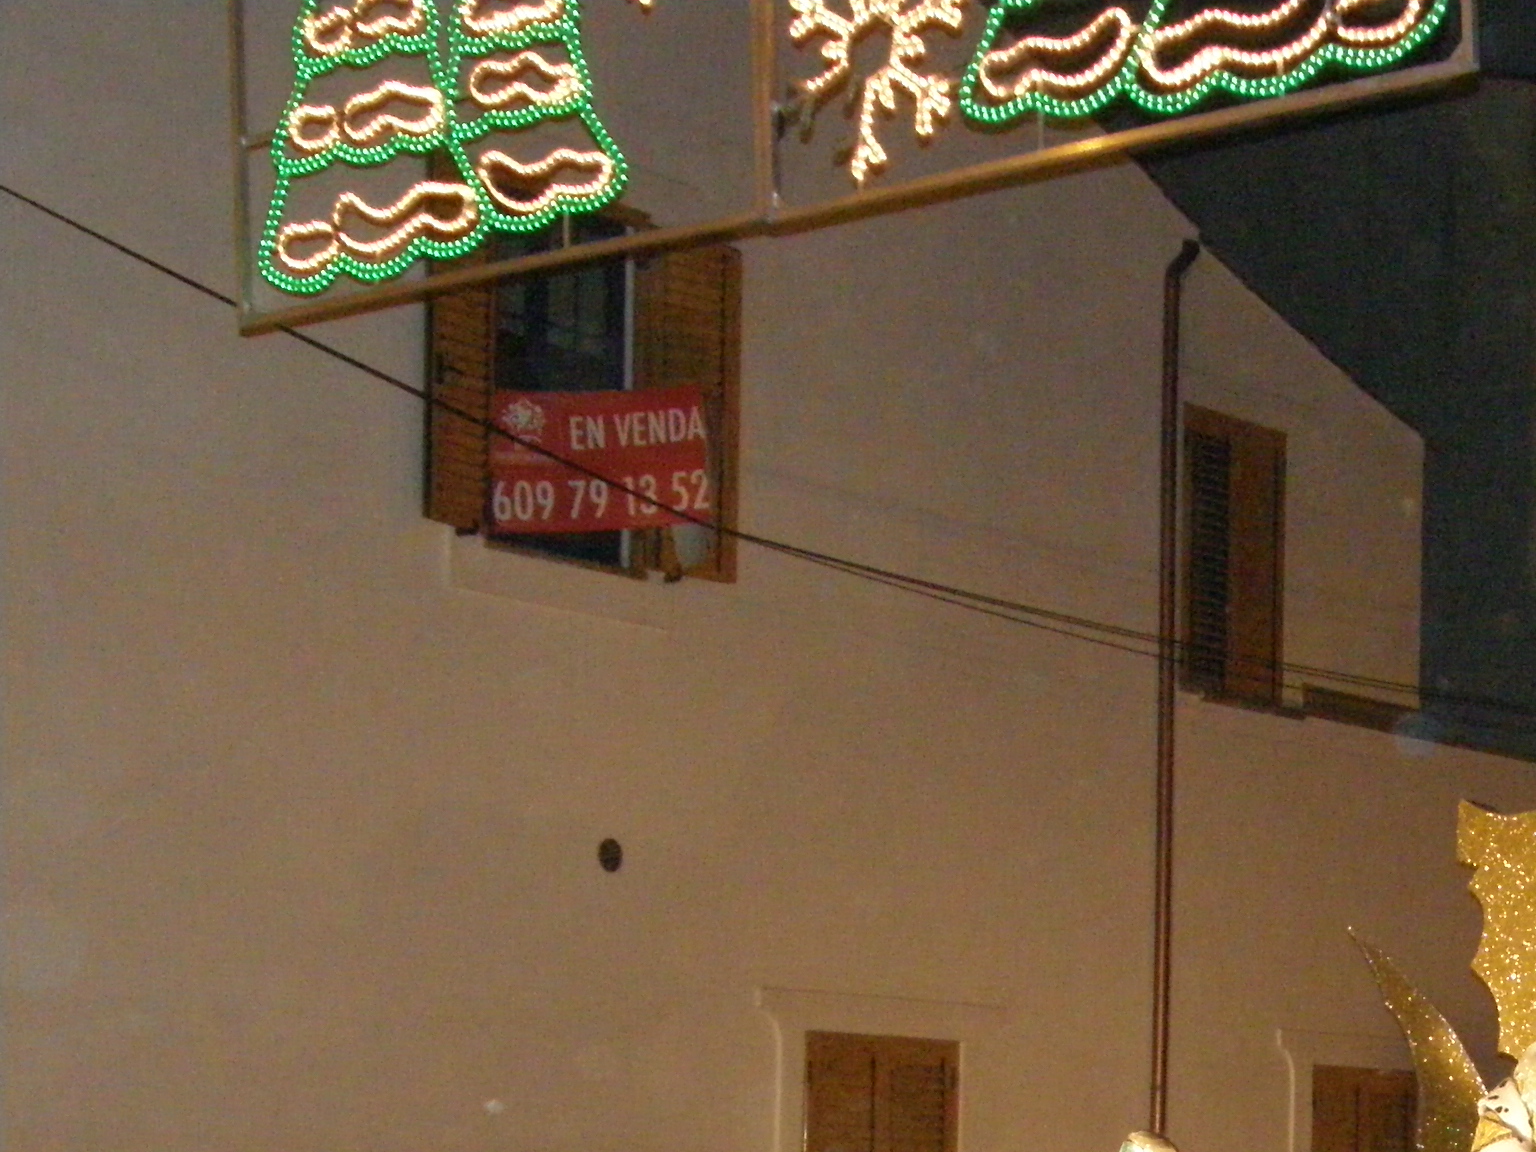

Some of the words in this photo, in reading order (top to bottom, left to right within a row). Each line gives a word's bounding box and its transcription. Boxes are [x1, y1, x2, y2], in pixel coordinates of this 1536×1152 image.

[568, 414, 606, 451] EN
[613, 404, 707, 448] VENDA
[493, 479, 555, 522] 609
[567, 478, 608, 520] 79
[622, 473, 658, 517] 13
[670, 468, 710, 512] 52
